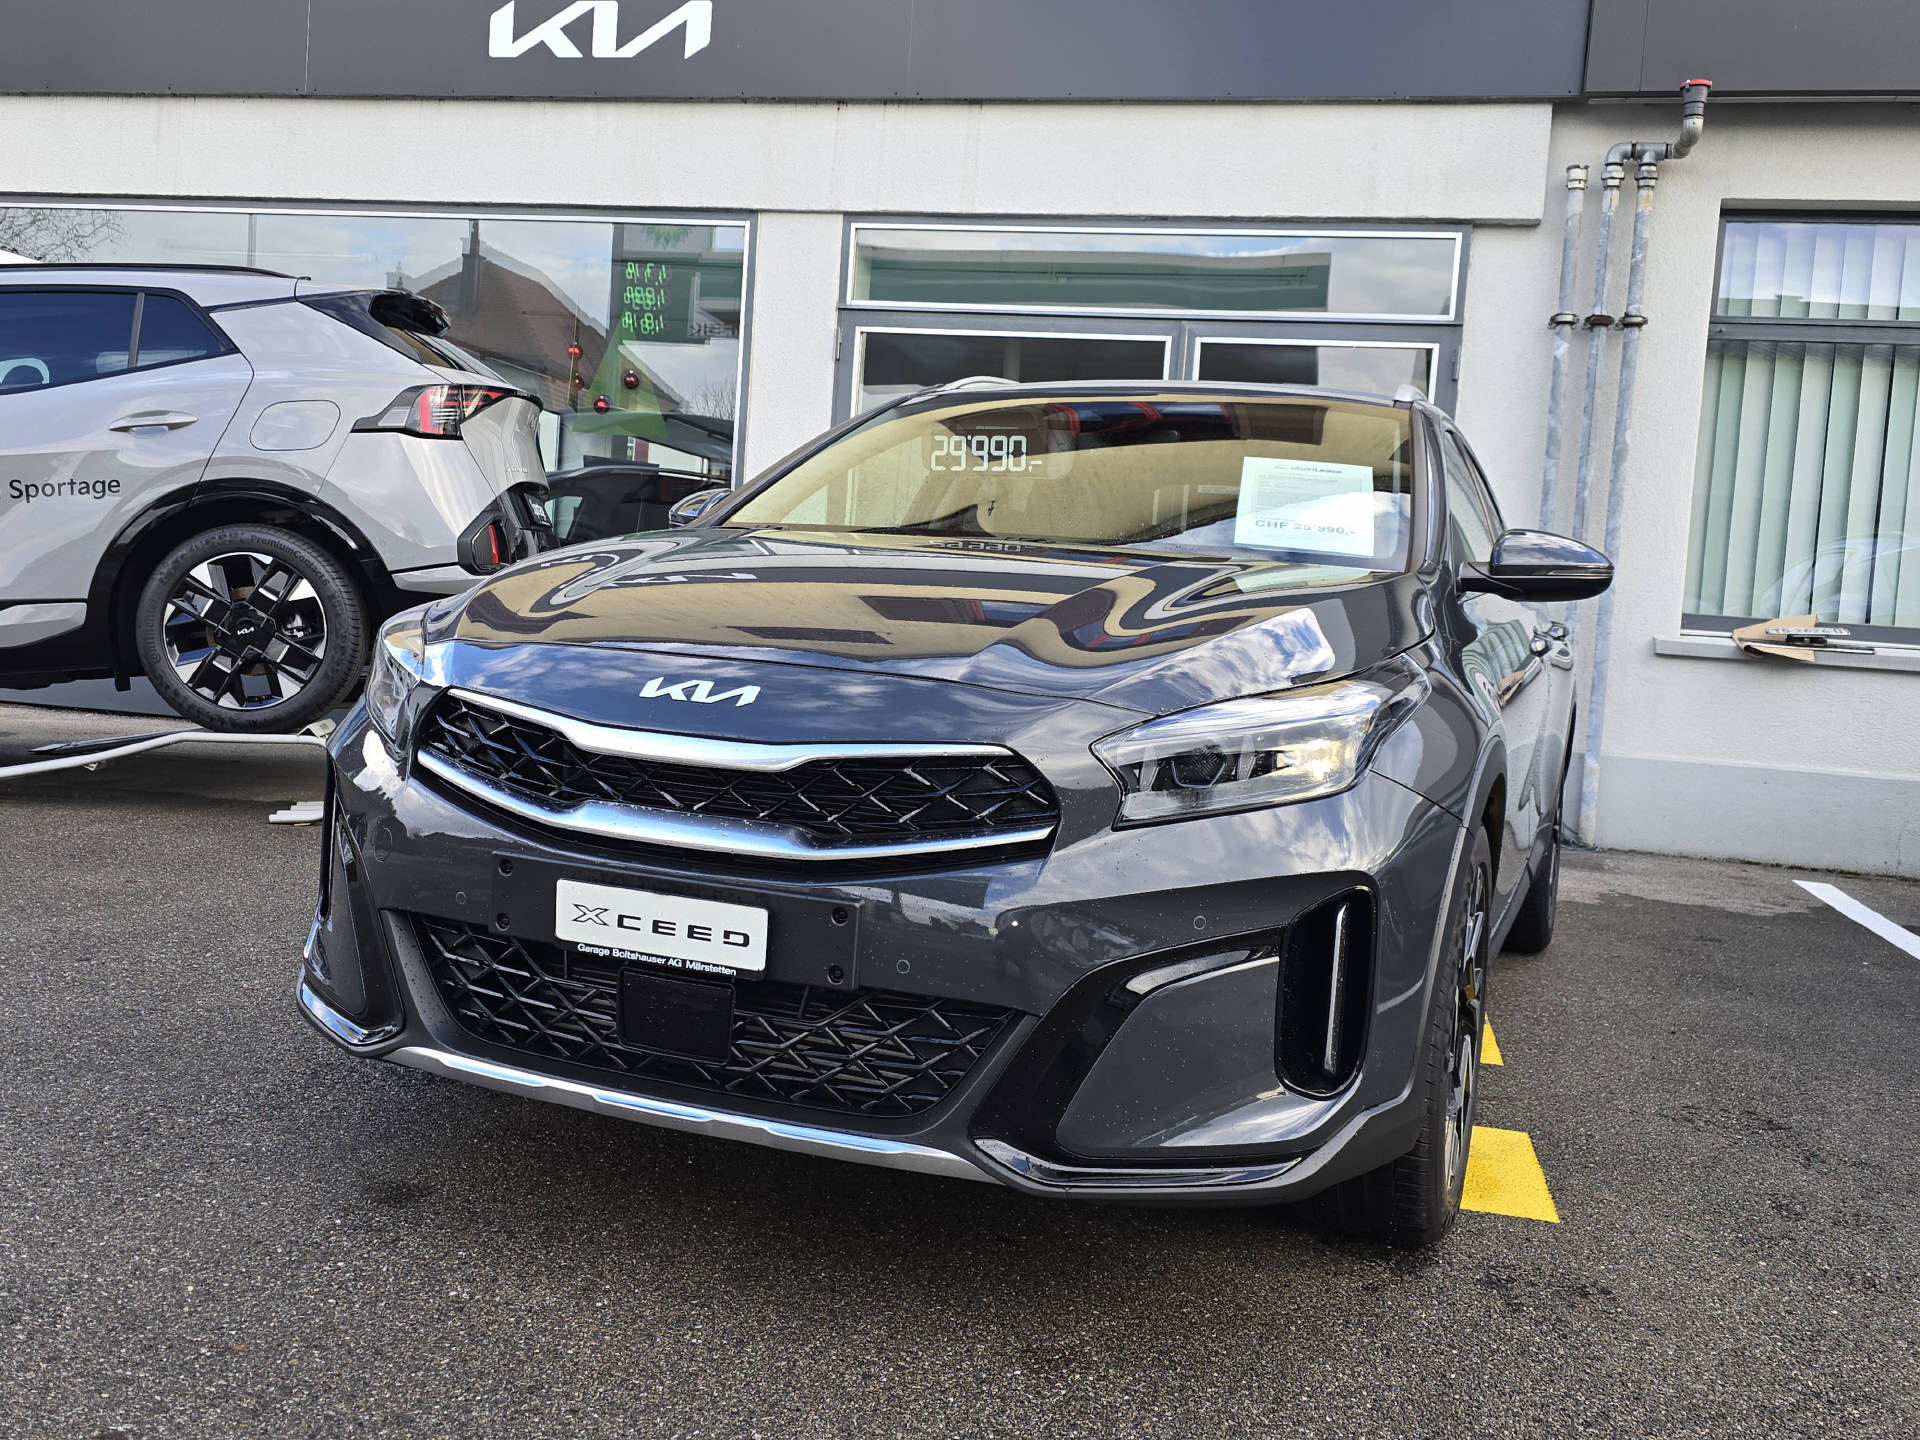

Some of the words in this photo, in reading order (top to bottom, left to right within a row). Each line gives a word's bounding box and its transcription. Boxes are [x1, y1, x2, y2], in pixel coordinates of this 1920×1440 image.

[489, 0, 713, 59] KIA
[9, 478, 121, 504] Sportage
[1255, 519, 1289, 529] CHF
[638, 676, 761, 707] KIA
[571, 902, 751, 949] XCEED
[577, 942, 611, 957] Garage
[612, 948, 667, 965] Boltshauser
[667, 957, 682, 968] AG
